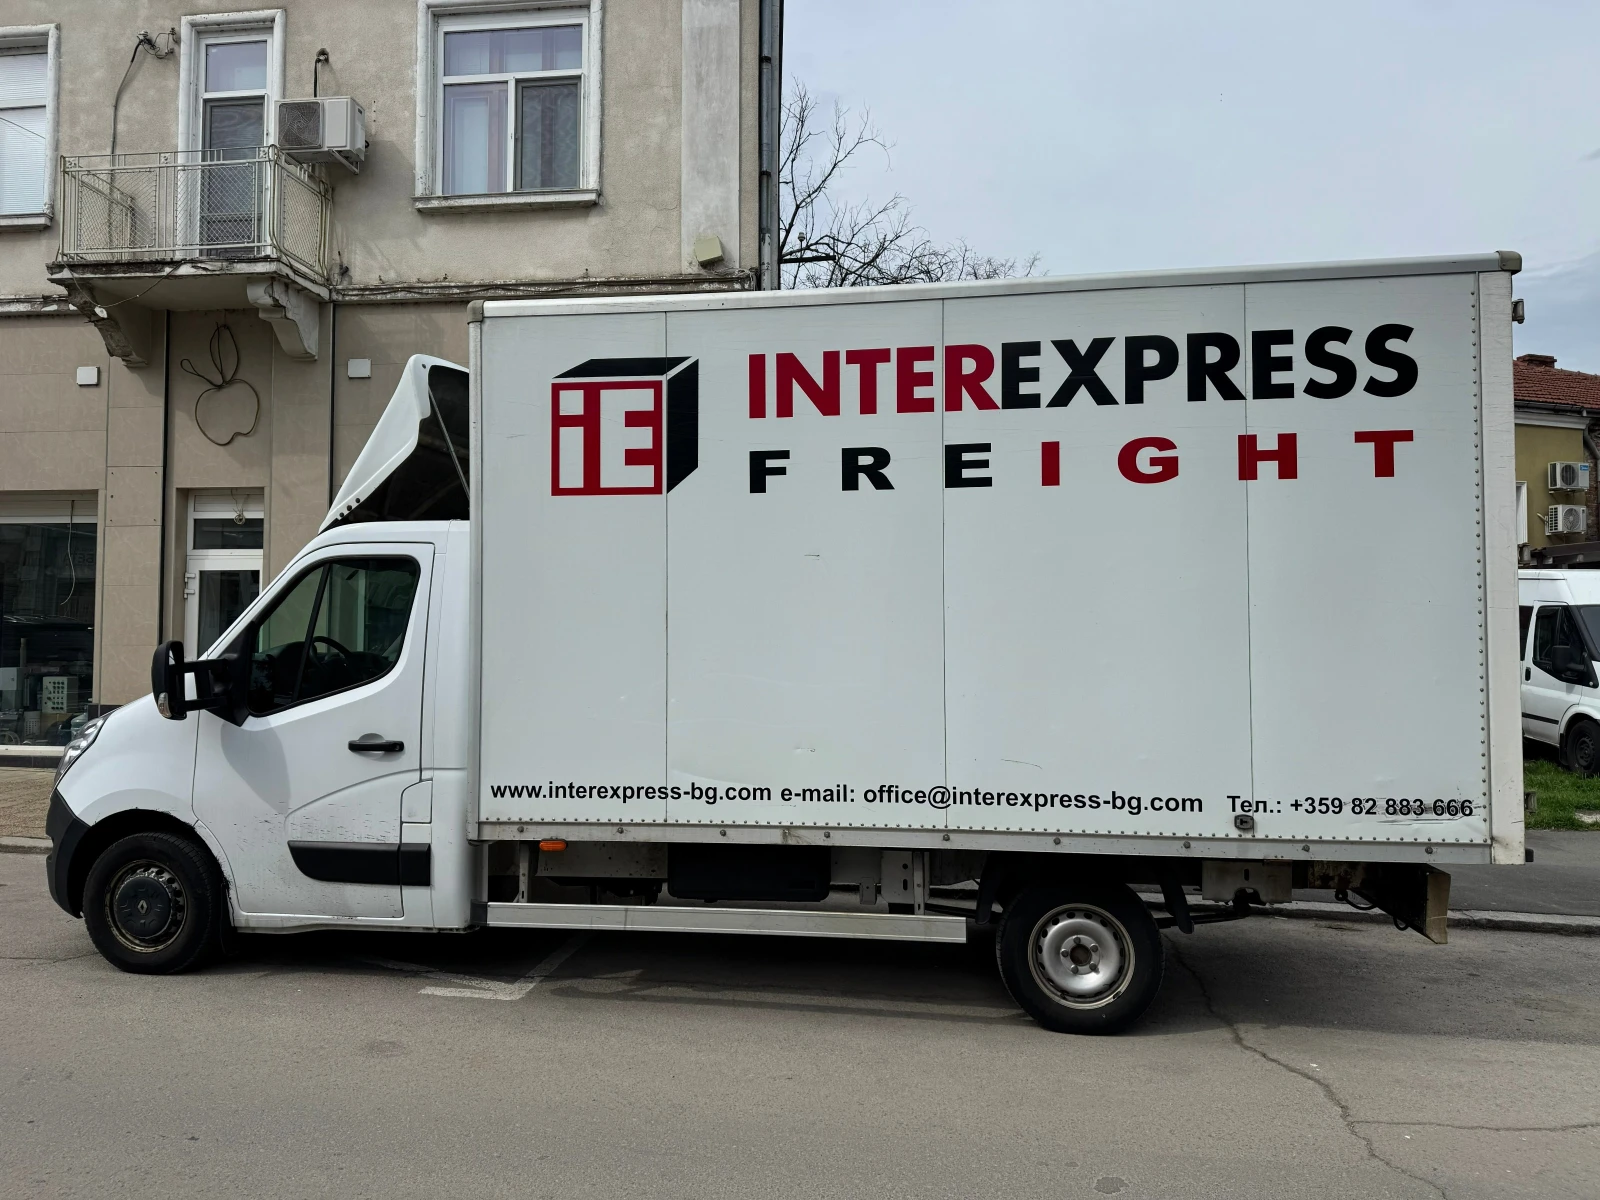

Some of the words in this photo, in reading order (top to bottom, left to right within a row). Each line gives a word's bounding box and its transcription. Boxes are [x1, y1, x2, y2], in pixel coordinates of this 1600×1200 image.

[748, 323, 1419, 419] INTEREXPRESS
[748, 429, 1414, 494] FREIGHT
[490, 780, 772, 805] www.interexpress-bg.com
[780, 783, 855, 803] e-mail:
[863, 784, 1203, 816] office@interexpress-bg.com
[1226, 795, 1282, 814] Тел.:
[1290, 796, 1343, 815] +359
[1351, 797, 1378, 816] 82
[1384, 798, 1425, 817] 883
[1432, 799, 1475, 817] 666
